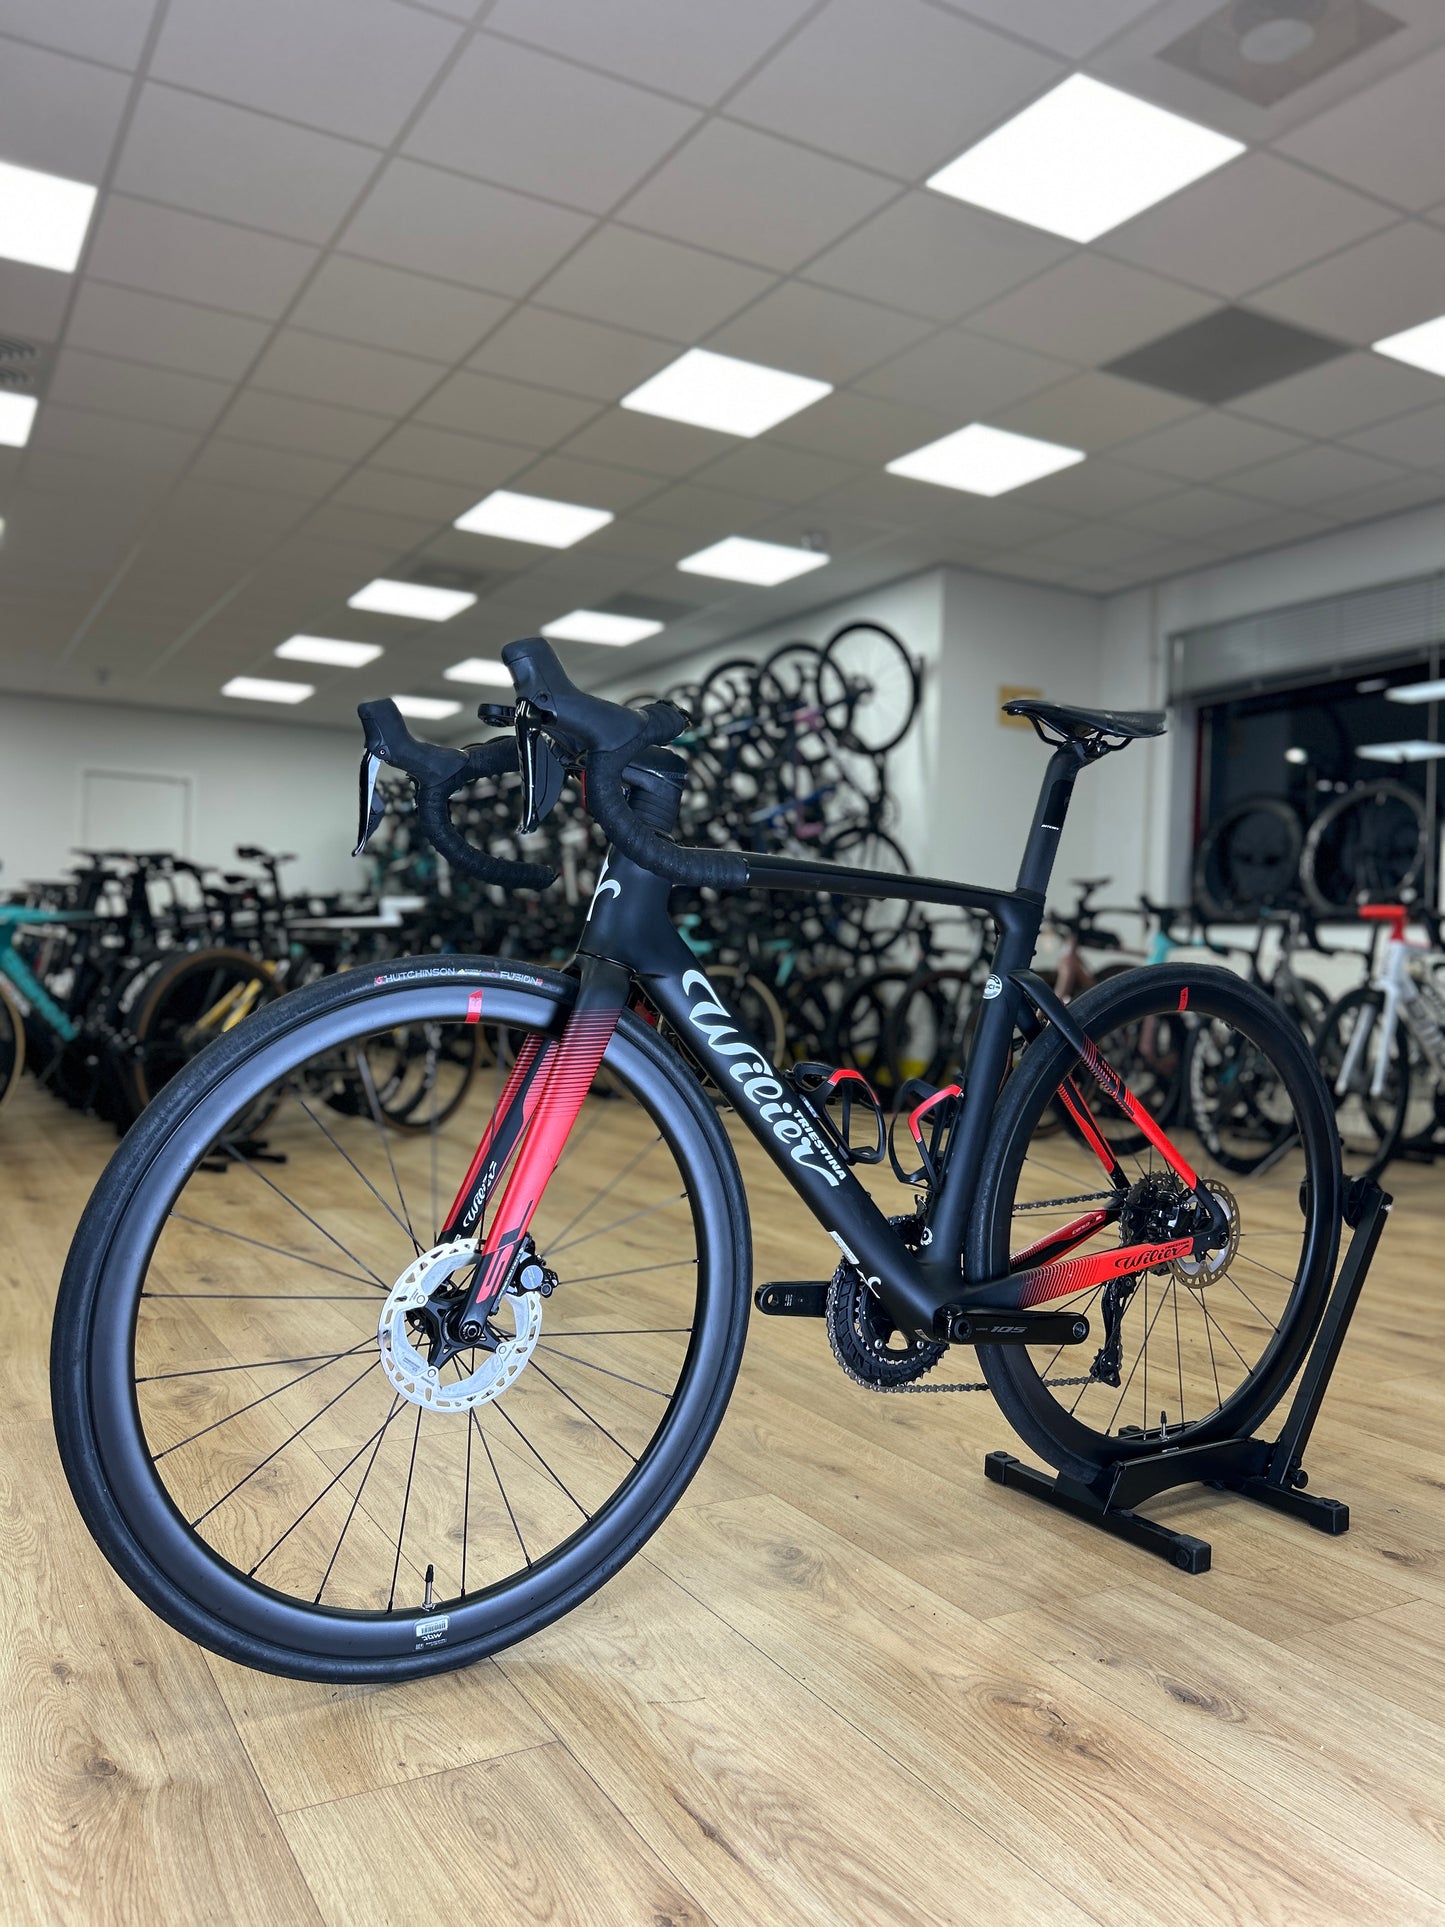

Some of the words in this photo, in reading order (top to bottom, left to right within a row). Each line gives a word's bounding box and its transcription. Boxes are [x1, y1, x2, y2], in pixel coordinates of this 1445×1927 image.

[384, 967, 455, 983] HUTCHINSON
[499, 971, 538, 985] FUSION
[682, 969, 841, 1187] Wilier
[793, 1109, 847, 1181] TRIESTINA
[1115, 1243, 1190, 1270] Wilier
[990, 1325, 1028, 1333] 105
